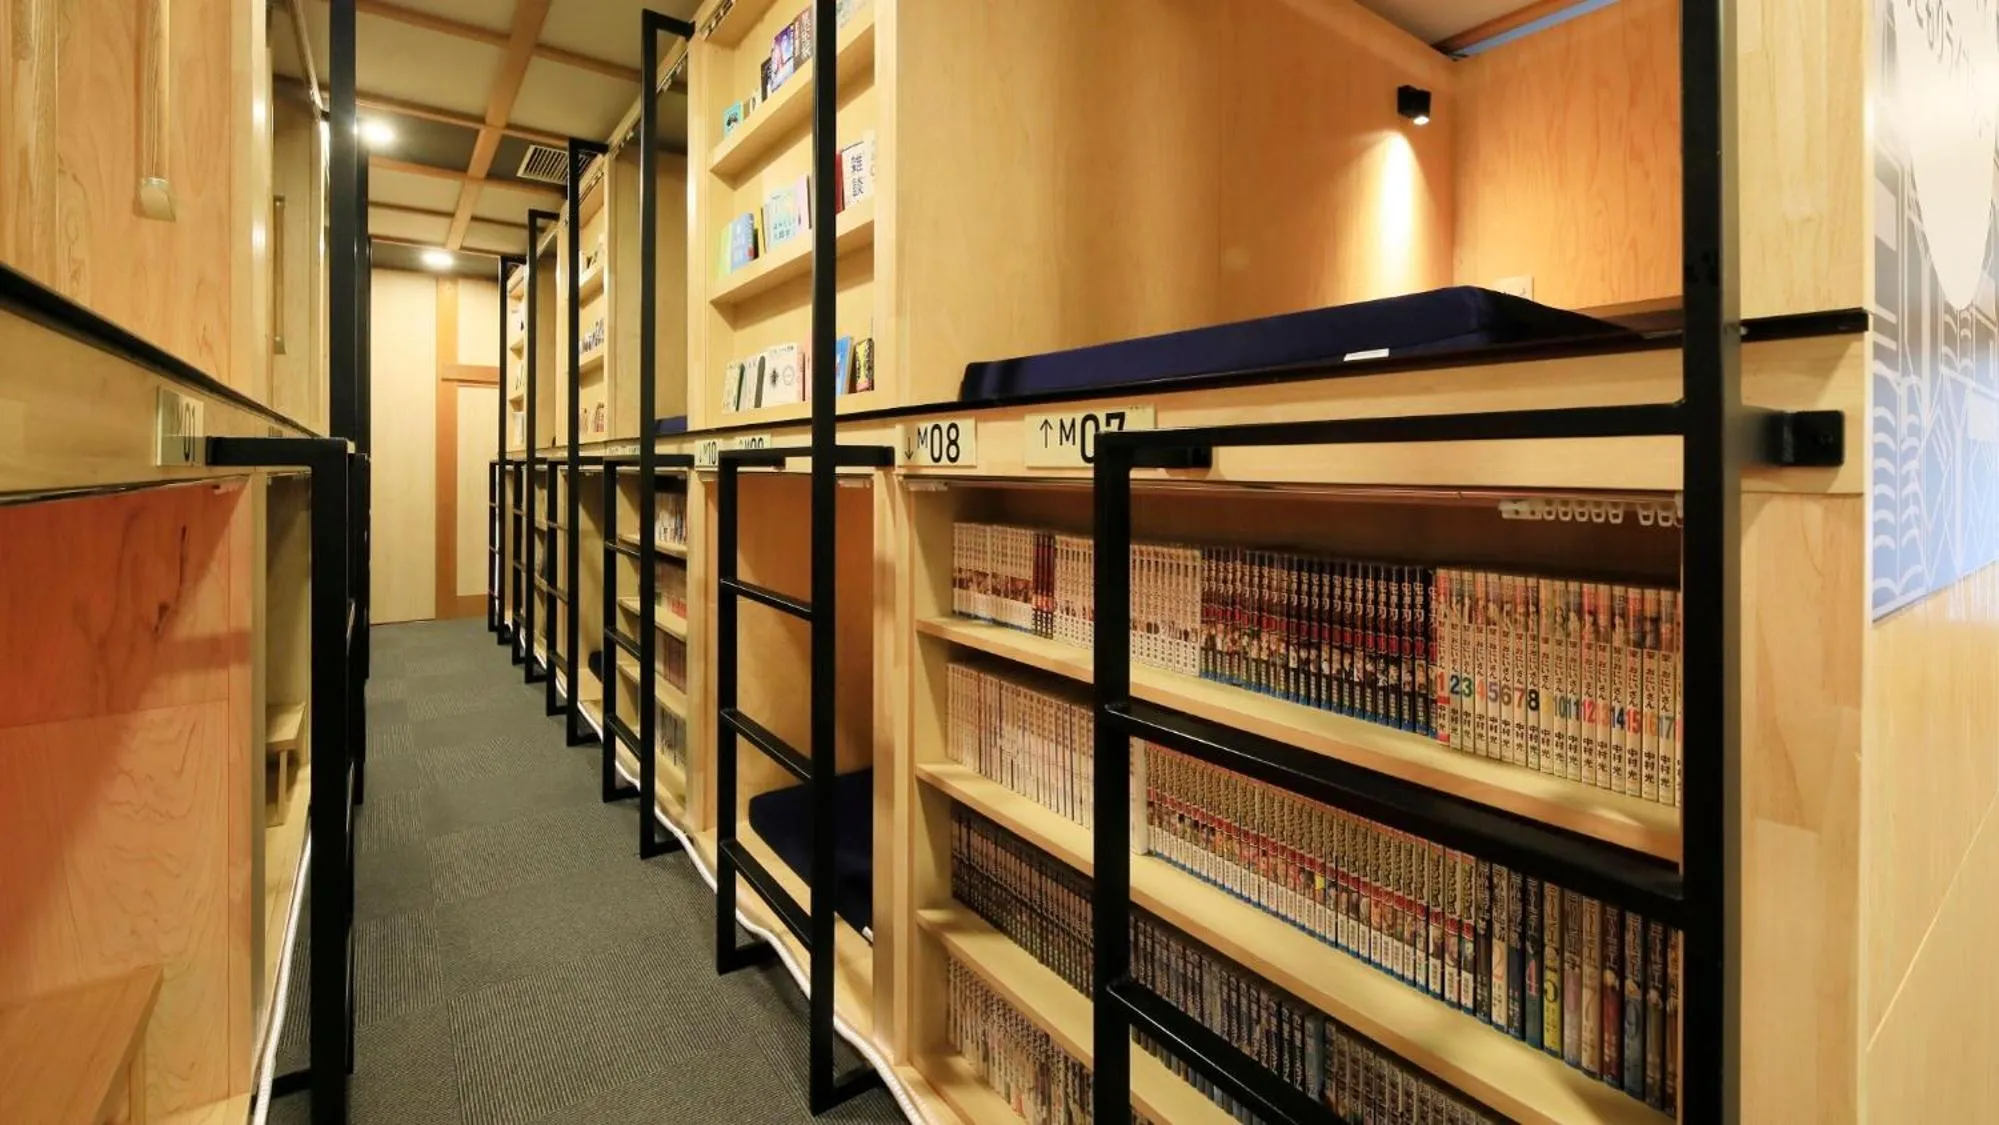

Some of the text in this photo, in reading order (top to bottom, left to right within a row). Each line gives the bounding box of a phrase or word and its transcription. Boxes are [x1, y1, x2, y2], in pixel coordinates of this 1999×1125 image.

[917, 422, 960, 463] M08
[1437, 671, 1445, 691] 1
[1450, 674, 1460, 695] 2
[1462, 677, 1472, 698] 3
[1488, 681, 1498, 702] 5
[1501, 684, 1512, 706] 6
[1515, 687, 1525, 708] 7
[1528, 689, 1540, 711] 8
[1555, 695, 1566, 718] 10
[1567, 698, 1580, 721] 11
[1583, 699, 1595, 724] 12
[1612, 706, 1624, 729] 14
[1627, 708, 1640, 733] 15
[1660, 715, 1673, 739] 17
